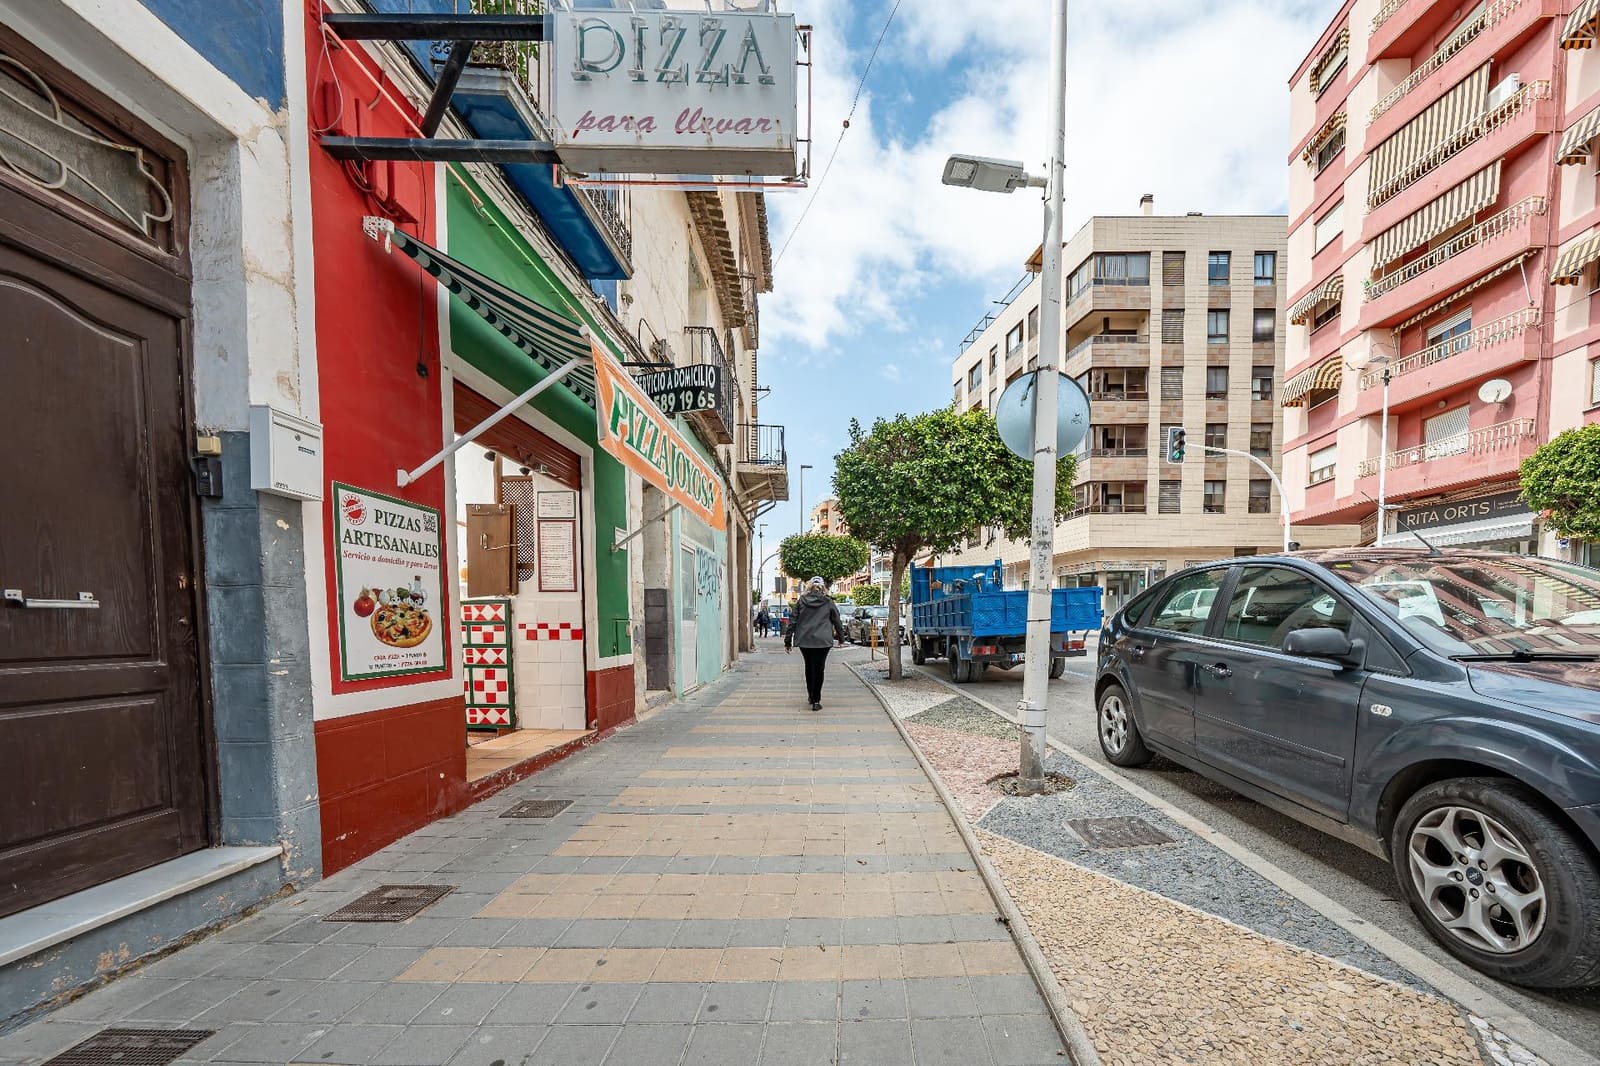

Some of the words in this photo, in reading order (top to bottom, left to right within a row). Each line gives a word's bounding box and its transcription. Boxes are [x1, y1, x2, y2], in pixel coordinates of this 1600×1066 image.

[571, 16, 776, 87] PIZZA
[572, 110, 657, 139] para
[674, 107, 772, 135] llevar
[667, 370, 674, 390] A
[674, 365, 716, 389] DOMICILIO
[680, 390, 694, 410] 19
[374, 508, 421, 533] PIZZAS
[1406, 511, 1440, 526] RITA
[1443, 501, 1490, 520] ORTS
[342, 528, 438, 558] ARTESANALES
[343, 550, 371, 561] Servicio
